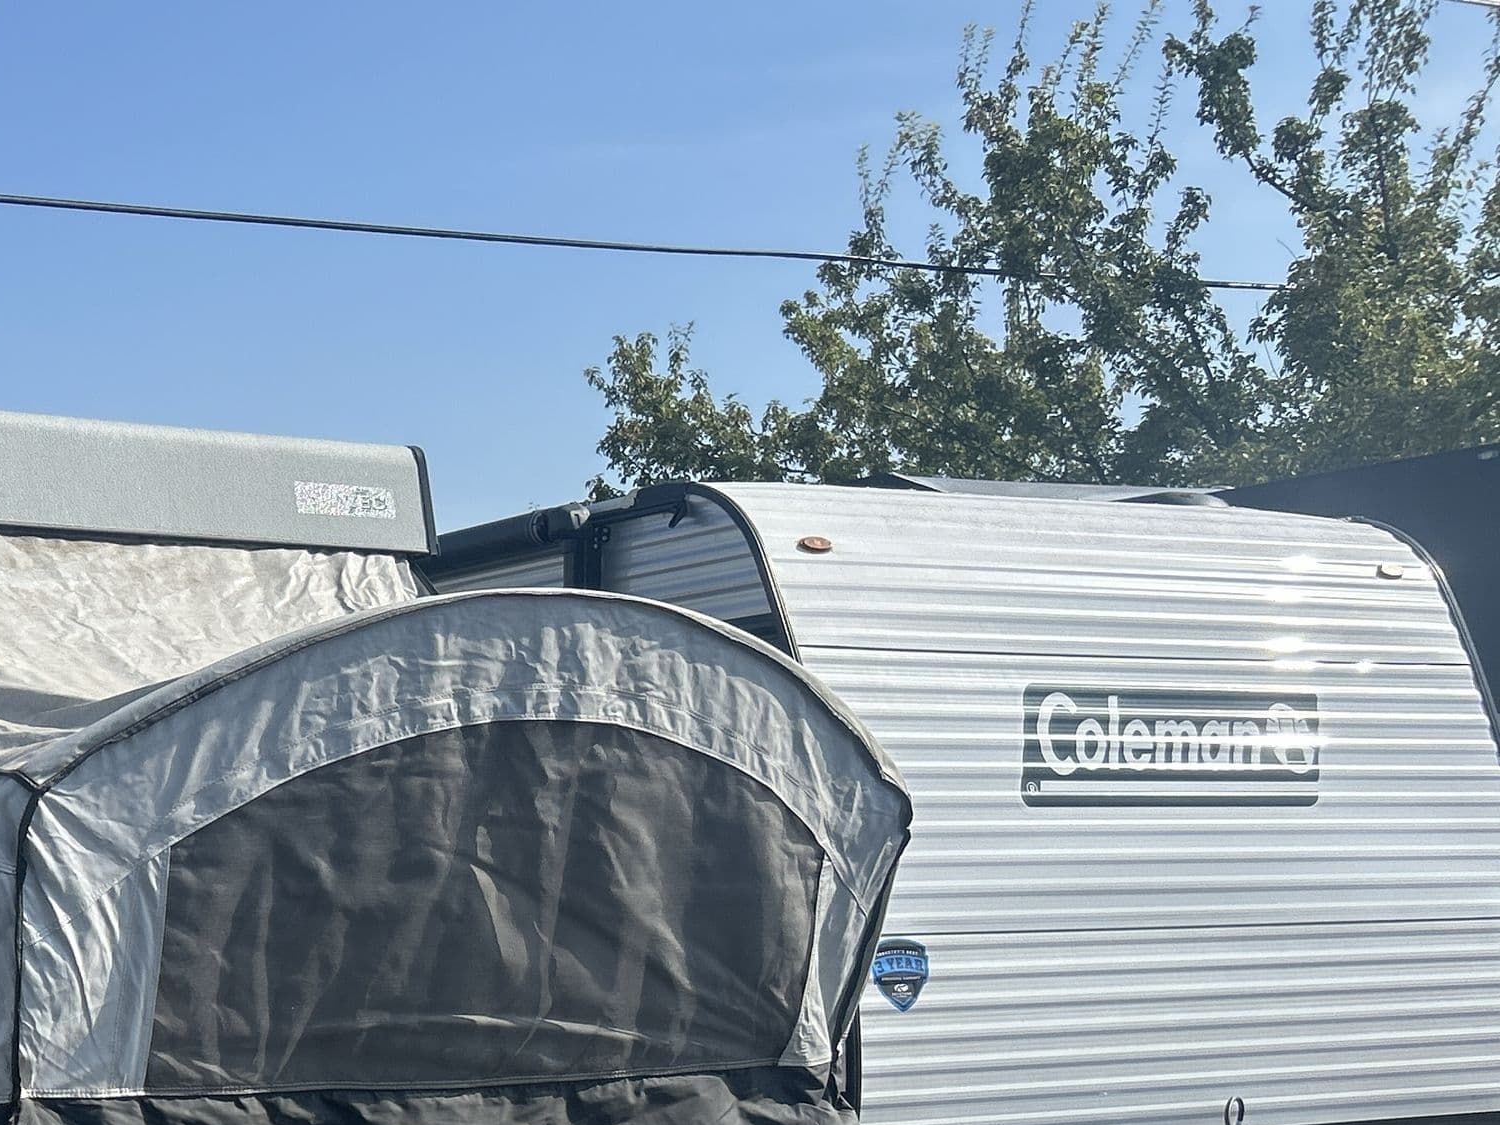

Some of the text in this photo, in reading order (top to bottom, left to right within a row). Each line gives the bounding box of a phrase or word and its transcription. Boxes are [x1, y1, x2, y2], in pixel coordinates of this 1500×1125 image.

[1037, 691, 1262, 776] Coleman
[874, 957, 924, 973] 3 YEAR
